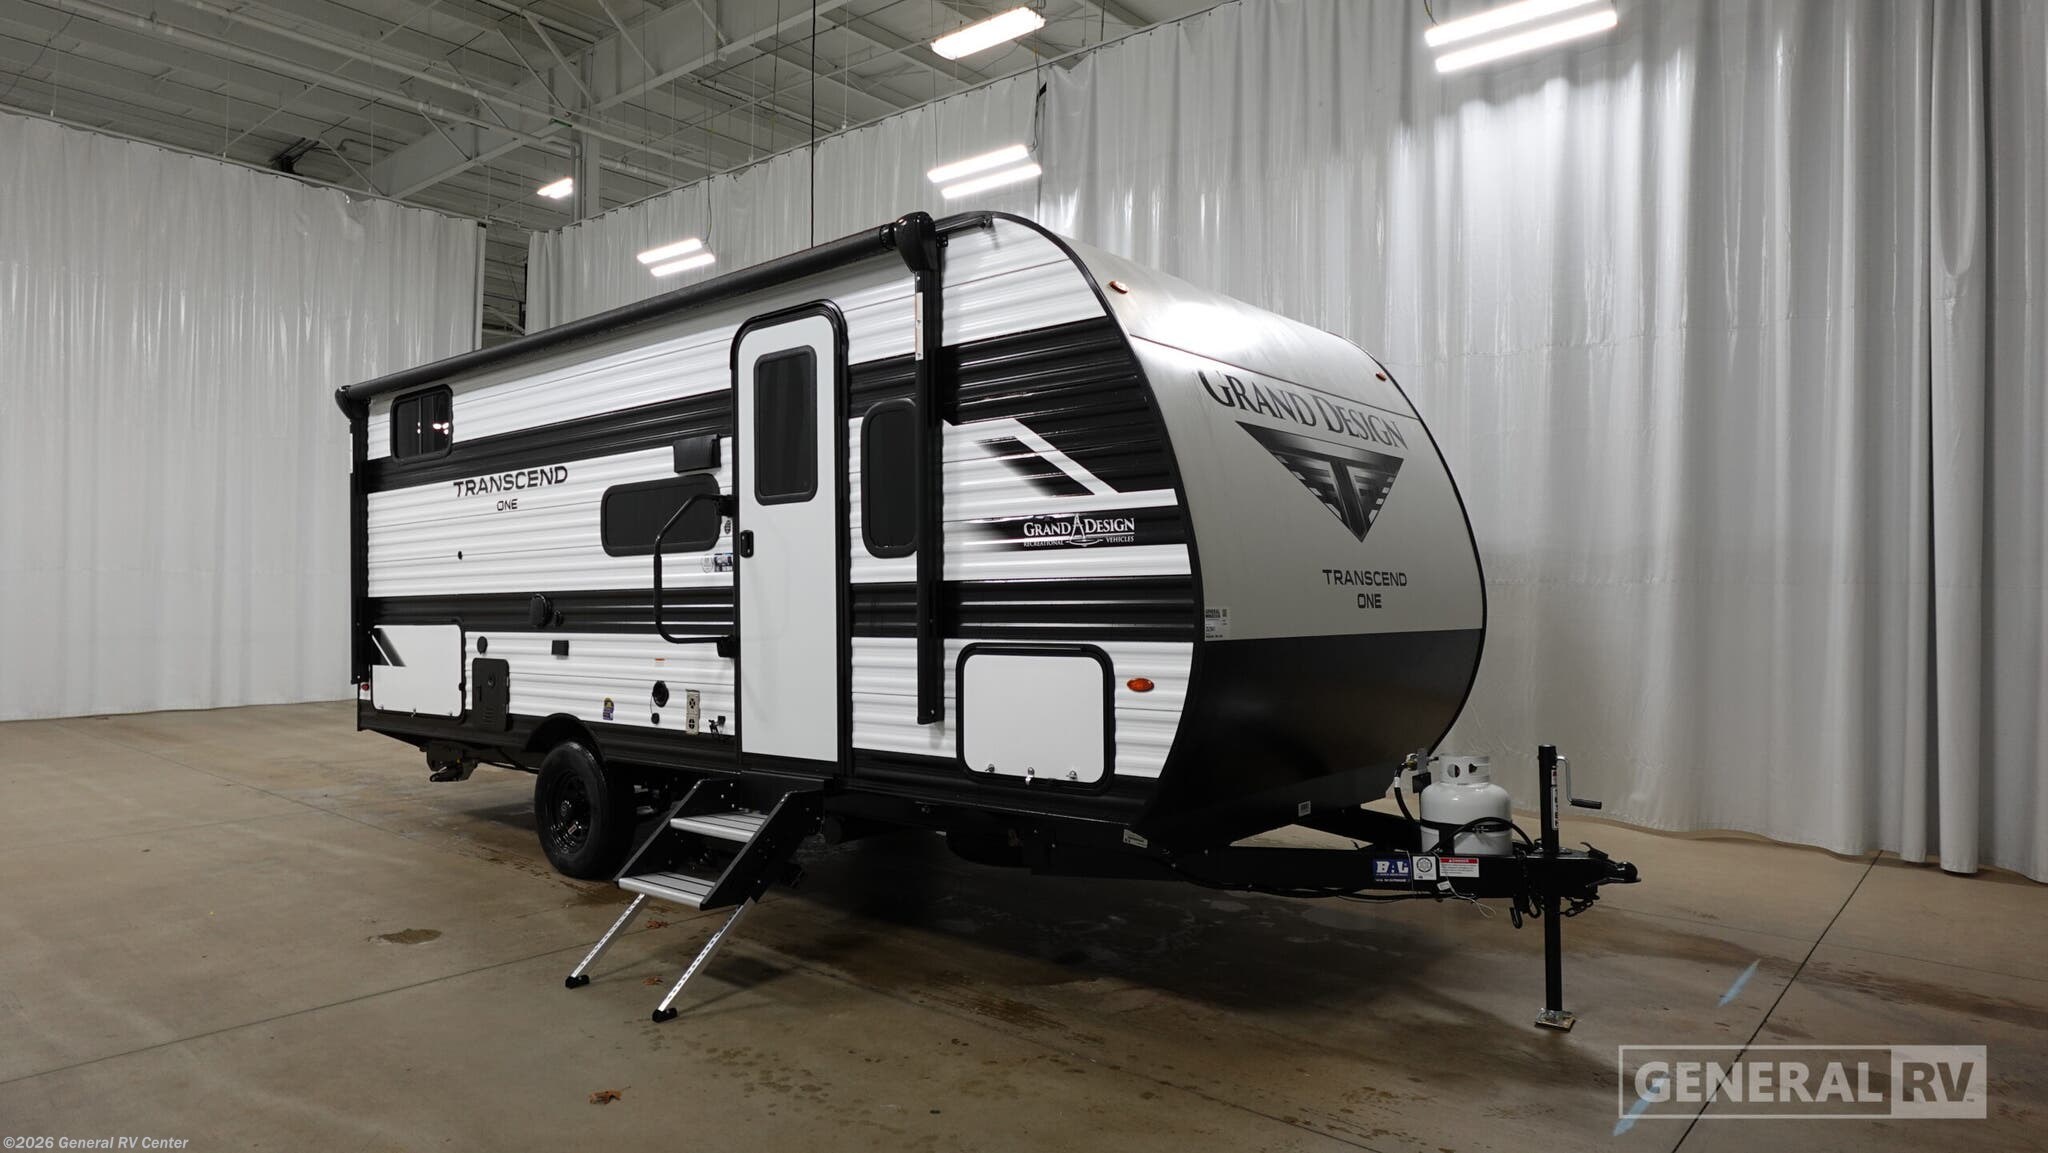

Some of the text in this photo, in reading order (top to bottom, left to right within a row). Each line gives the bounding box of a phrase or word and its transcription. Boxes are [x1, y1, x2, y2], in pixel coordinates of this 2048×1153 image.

[1198, 371, 1409, 450] GRAND DESIGN
[453, 465, 568, 497] TRANSCEND
[496, 498, 518, 511] ONE
[1023, 518, 1135, 537] GRAND DESIGN
[1105, 535, 1135, 543] VEHICLES
[1322, 569, 1408, 586] TRANSCEND
[1357, 593, 1382, 608] ONE
